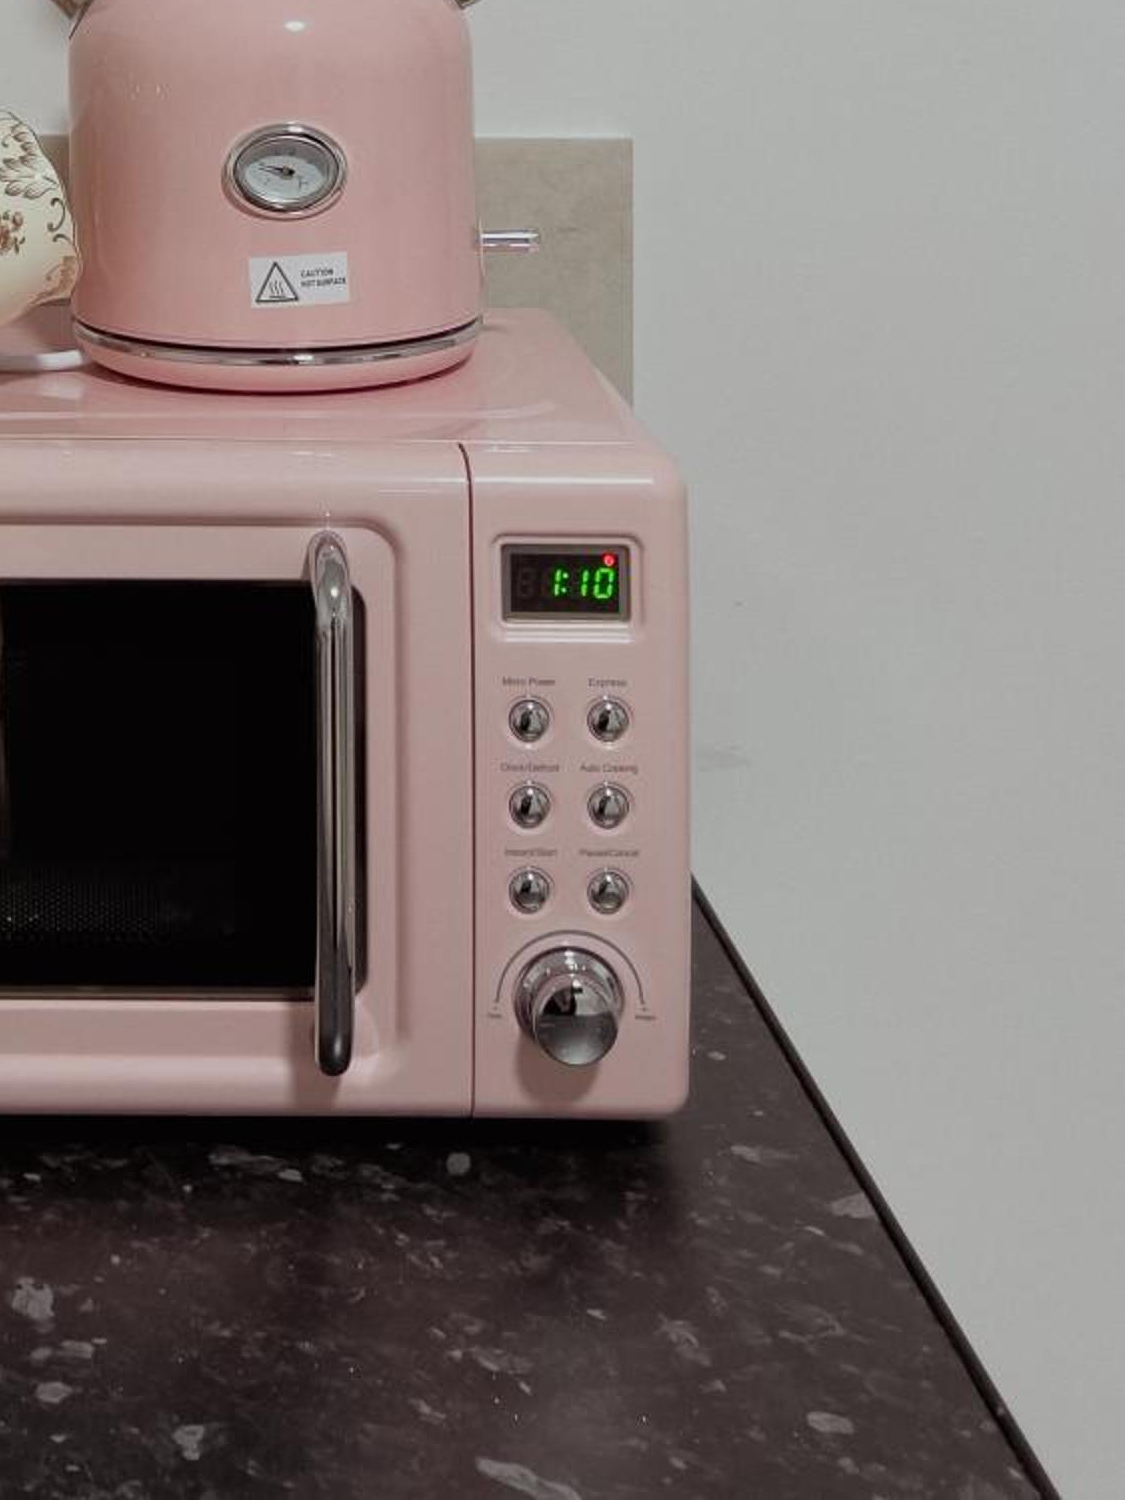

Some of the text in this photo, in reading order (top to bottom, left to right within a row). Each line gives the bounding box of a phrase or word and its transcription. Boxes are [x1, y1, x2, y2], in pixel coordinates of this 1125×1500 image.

[300, 268, 334, 277] CAUTION
[301, 277, 346, 287] HOT SURFACE
[553, 567, 616, 599] 1:10
[588, 677, 628, 688] Express
